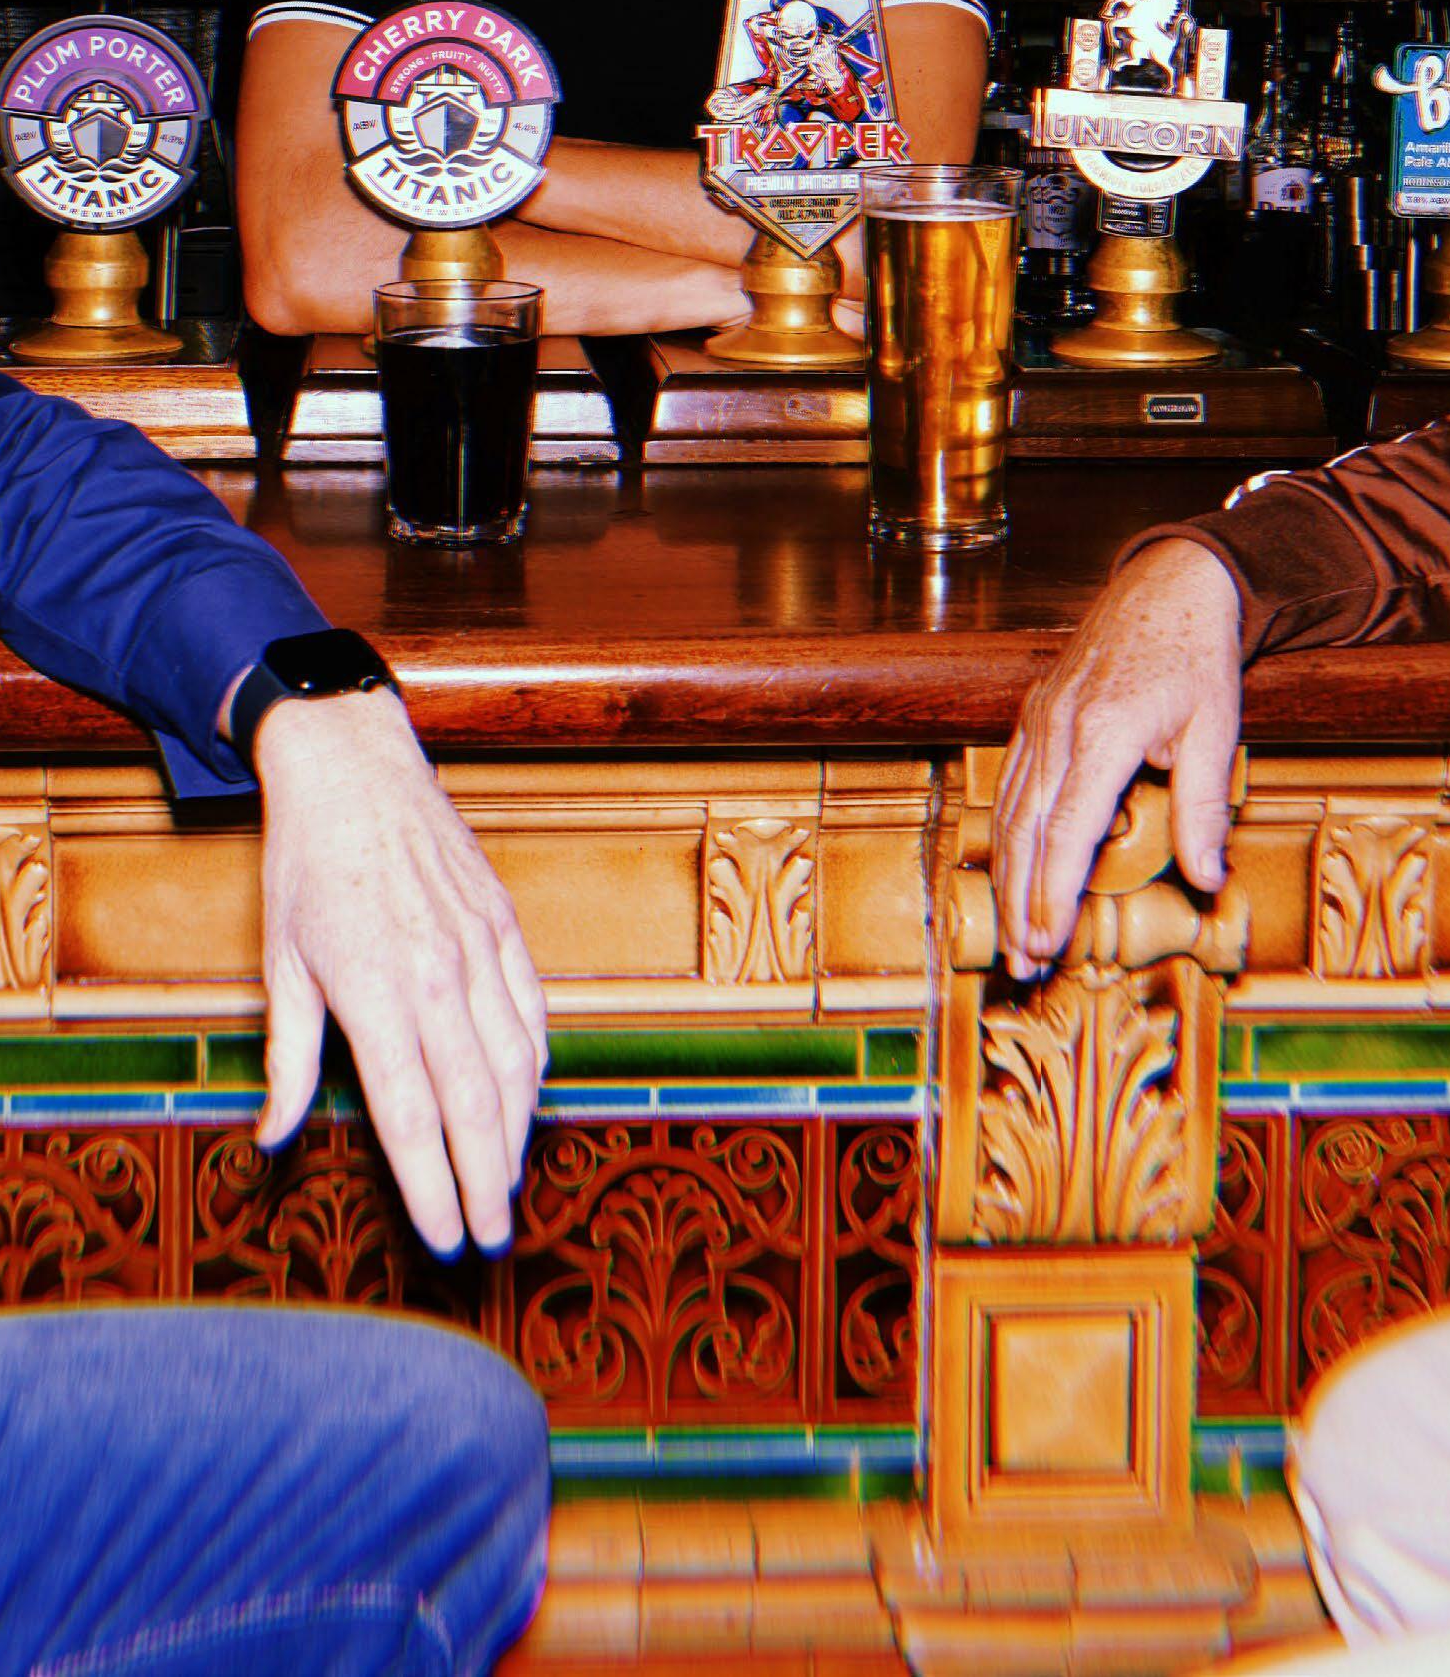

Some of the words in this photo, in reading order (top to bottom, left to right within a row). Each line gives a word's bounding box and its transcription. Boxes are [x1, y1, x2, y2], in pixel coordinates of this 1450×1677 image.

[14, 39, 81, 104] PLUM
[89, 35, 187, 108] PORTER
[352, 8, 467, 83] CHERRY
[473, 15, 545, 88] DARK
[388, 57, 426, 95] STRONG
[430, 50, 473, 64] FRUITY
[476, 61, 506, 96] NUTTY
[688, 119, 912, 175] TROOPER
[1046, 112, 1243, 158] UNICORN
[376, 157, 514, 206] TITANIC
[745, 175, 795, 191] PREMIUM
[797, 174, 840, 190] BRITISH
[1403, 155, 1434, 168] Pale
[37, 162, 164, 209] TITANIC
